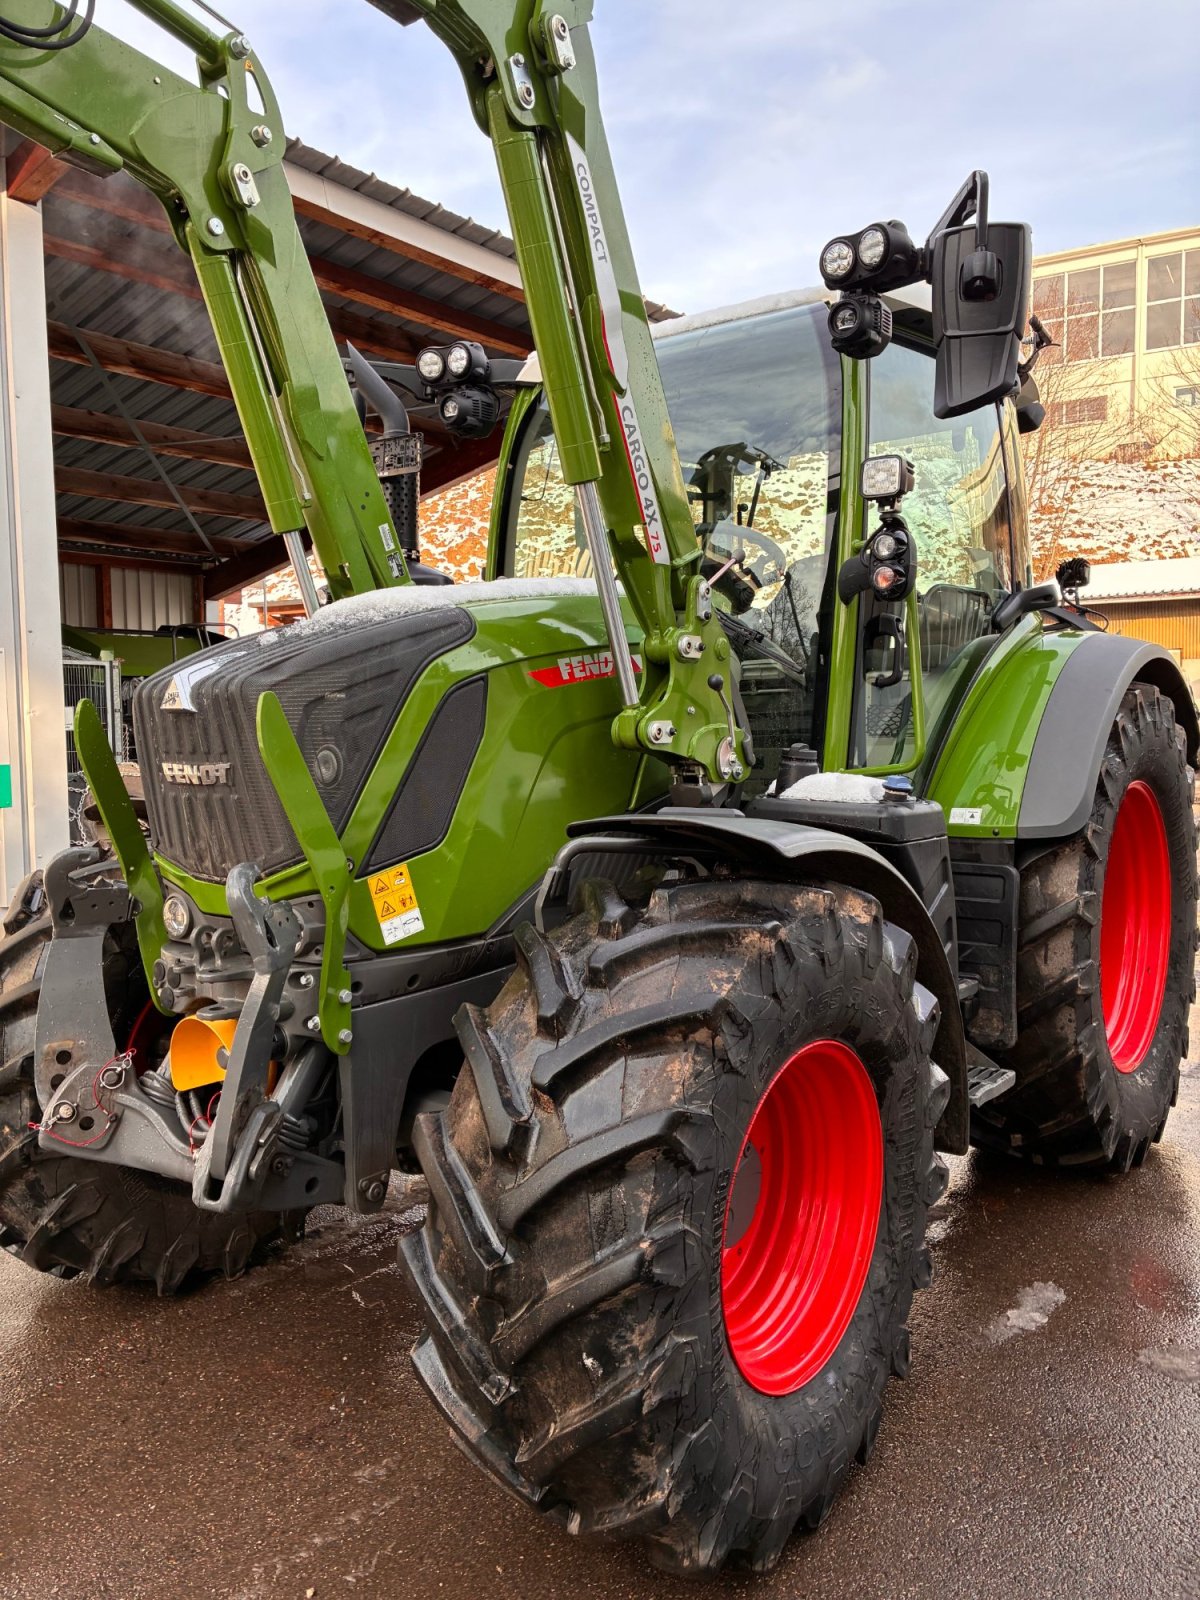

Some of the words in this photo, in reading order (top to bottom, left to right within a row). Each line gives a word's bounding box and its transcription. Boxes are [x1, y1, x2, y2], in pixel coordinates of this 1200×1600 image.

[577, 162, 608, 264] COMPACT
[621, 405, 649, 491] CARGO
[643, 496, 658, 527] 4X
[650, 530, 662, 553] 75
[557, 651, 615, 681] FEND
[161, 762, 231, 785] FENDT
